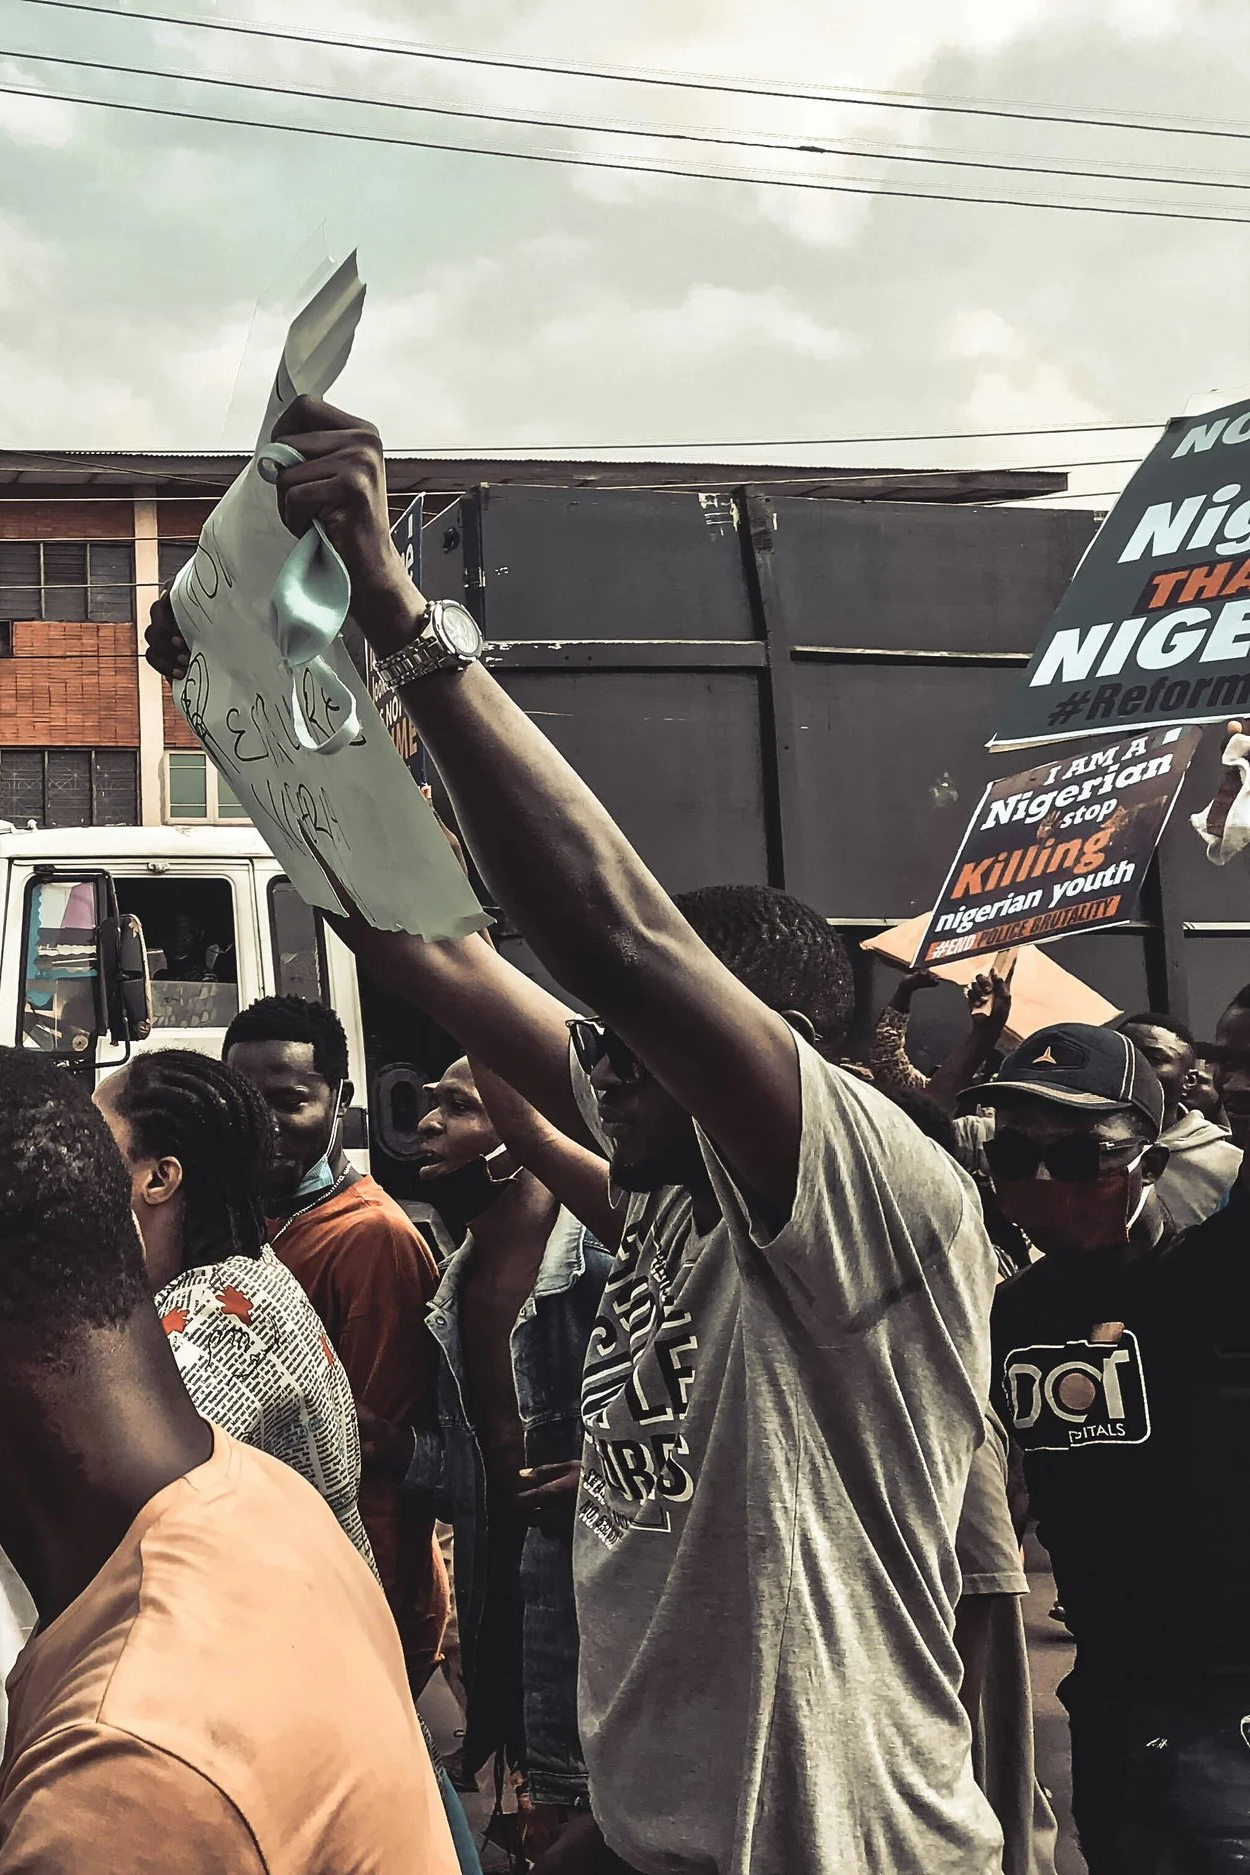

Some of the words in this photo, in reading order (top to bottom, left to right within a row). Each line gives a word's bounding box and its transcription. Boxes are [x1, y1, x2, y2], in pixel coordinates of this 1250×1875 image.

[980, 753, 1175, 831] Nigerian
[1044, 765, 1060, 787] I
[1061, 746, 1120, 781] AM
[1121, 736, 1149, 762] A
[1060, 798, 1118, 830] stop
[950, 827, 1114, 900] Killing
[932, 934, 977, 959] #END
[977, 921, 1030, 946] POLICE
[1030, 899, 1116, 933] BRUTALITY
[934, 888, 1043, 935] nigerian
[1048, 859, 1136, 909] youth
